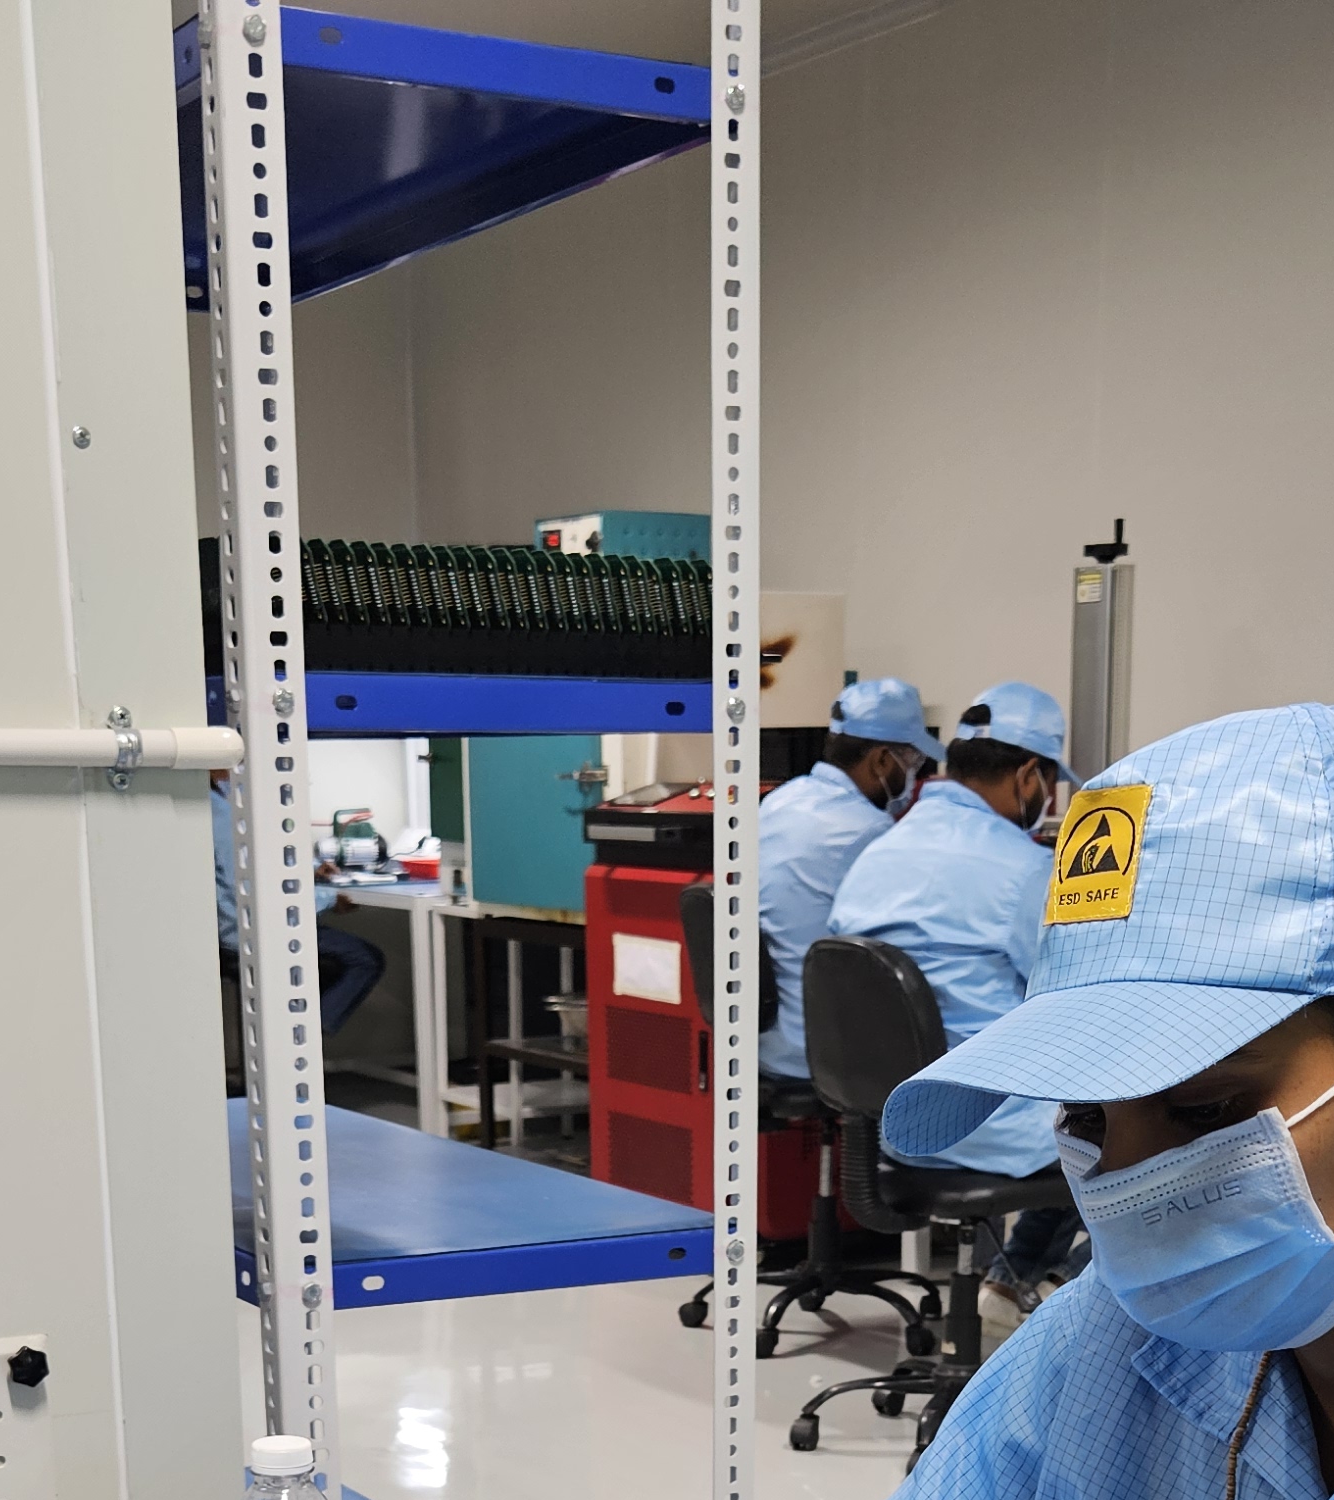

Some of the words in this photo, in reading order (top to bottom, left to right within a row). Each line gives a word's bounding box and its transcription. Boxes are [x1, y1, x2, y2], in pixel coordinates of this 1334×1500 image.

[1058, 892, 1081, 906] ESD
[1086, 887, 1120, 903] SAFE
[1140, 1178, 1242, 1226] SALUS
